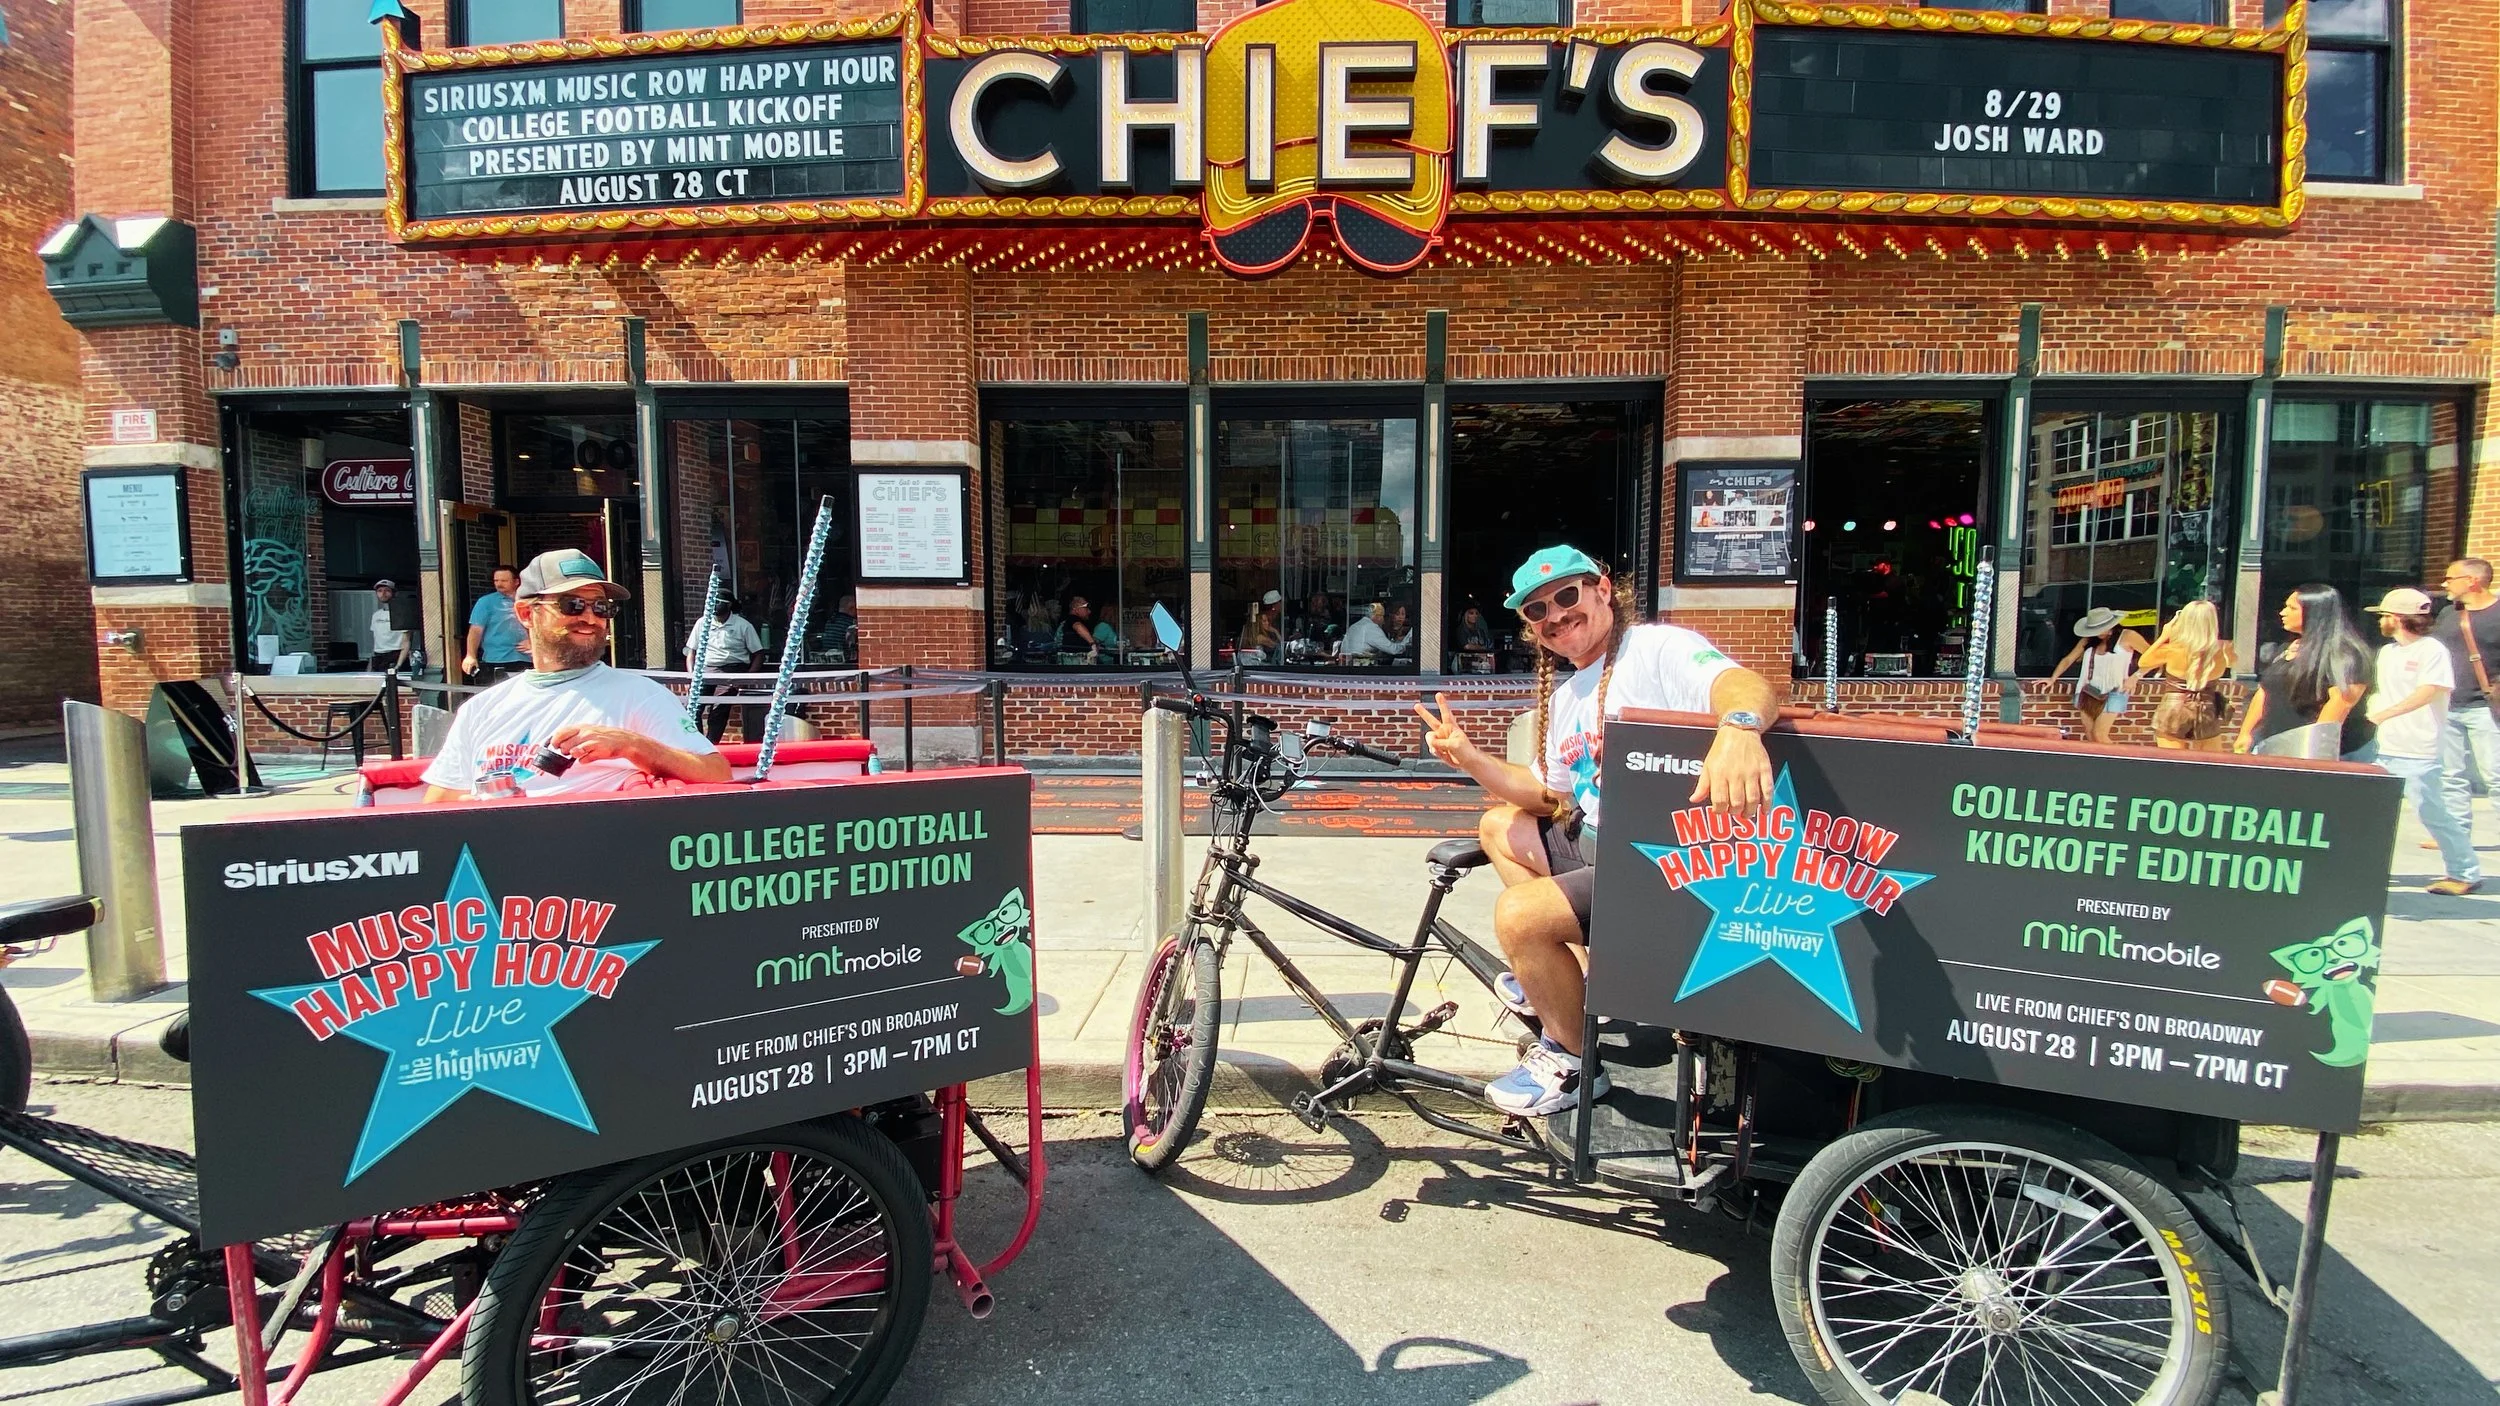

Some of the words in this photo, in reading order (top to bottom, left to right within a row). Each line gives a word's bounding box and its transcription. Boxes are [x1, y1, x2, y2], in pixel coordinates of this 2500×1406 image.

[424, 80, 546, 114] SIRIUSXM
[557, 74, 635, 104] MUSIC
[648, 69, 707, 96] ROW
[720, 62, 810, 92] HAPPY
[823, 56, 896, 86] HOUR
[1984, 89, 2062, 119] 8/29
[462, 111, 569, 144] COLLEGE
[580, 102, 717, 134] FOOTBALL
[727, 94, 843, 126] KICKOFF
[948, 40, 1708, 190] CHIEF'S
[1934, 123, 2009, 153] JOSH
[2023, 126, 2104, 156] WARD
[469, 141, 610, 177] PRESENTED
[620, 140, 655, 165] BY
[667, 135, 731, 162] MINT
[743, 129, 844, 160] MOBILE
[560, 173, 659, 205] AUGUST
[672, 171, 704, 198] 28
[715, 169, 749, 196] CT
[121, 414, 147, 425] FIRE
[122, 484, 143, 493] MENU
[333, 464, 399, 491] Culture
[873, 486, 947, 501] CHIEF'S
[1725, 476, 1772, 486] CHIEF'S
[1625, 751, 1704, 776] Sirius
[669, 823, 826, 871] COLLEGE
[837, 809, 988, 854] FOOTBALL
[1671, 805, 1795, 847] MUSIC
[1802, 809, 1900, 866] ROW
[1951, 782, 2118, 830] COLLEGE
[2127, 796, 2331, 849] FOOTBALL
[224, 850, 419, 889] SiriusXM
[691, 866, 840, 917] KICKOFF
[850, 851, 973, 896] EDITION
[1657, 842, 1786, 891] HAPPY
[1792, 847, 1903, 918] HOUR
[1965, 828, 2129, 878] KICKOFF
[2136, 845, 2303, 895] EDITION
[1733, 882, 1815, 917] Live
[2076, 897, 2149, 919] PRESENTED
[2151, 906, 2171, 921] BY
[307, 897, 486, 979] MUSIC
[500, 895, 616, 944] ROW
[802, 920, 863, 940] PRESENTED
[865, 917, 880, 932] BY
[1744, 922, 1823, 958] highway
[291, 944, 478, 1042] HAPPY
[492, 942, 627, 999] HOUR
[416, 997, 527, 1047] Live
[717, 1042, 750, 1065] LIVE
[755, 1033, 798, 1057] FROM
[803, 1021, 858, 1048] CHIEF'S
[862, 1018, 881, 1037] ON
[886, 1003, 960, 1030] BROADWAY
[1975, 991, 2011, 1014] LIVE
[2014, 996, 2062, 1021] FROM
[2067, 1004, 2130, 1030] CHIEF'S
[2135, 1012, 2159, 1034] ON
[2165, 1017, 2264, 1047] BROADWAY
[435, 1044, 541, 1081] highway
[691, 1067, 782, 1108] AUGUST
[786, 1061, 814, 1088] 28
[843, 1045, 887, 1075] 3PM
[957, 1027, 980, 1051] CT
[1946, 1018, 2041, 1055] AUGUST
[2043, 1032, 2077, 1059] 28
[2109, 1042, 2163, 1073] 3PM
[2254, 1062, 2289, 1089] CT
[2159, 1228, 2212, 1335] MAXXIS
